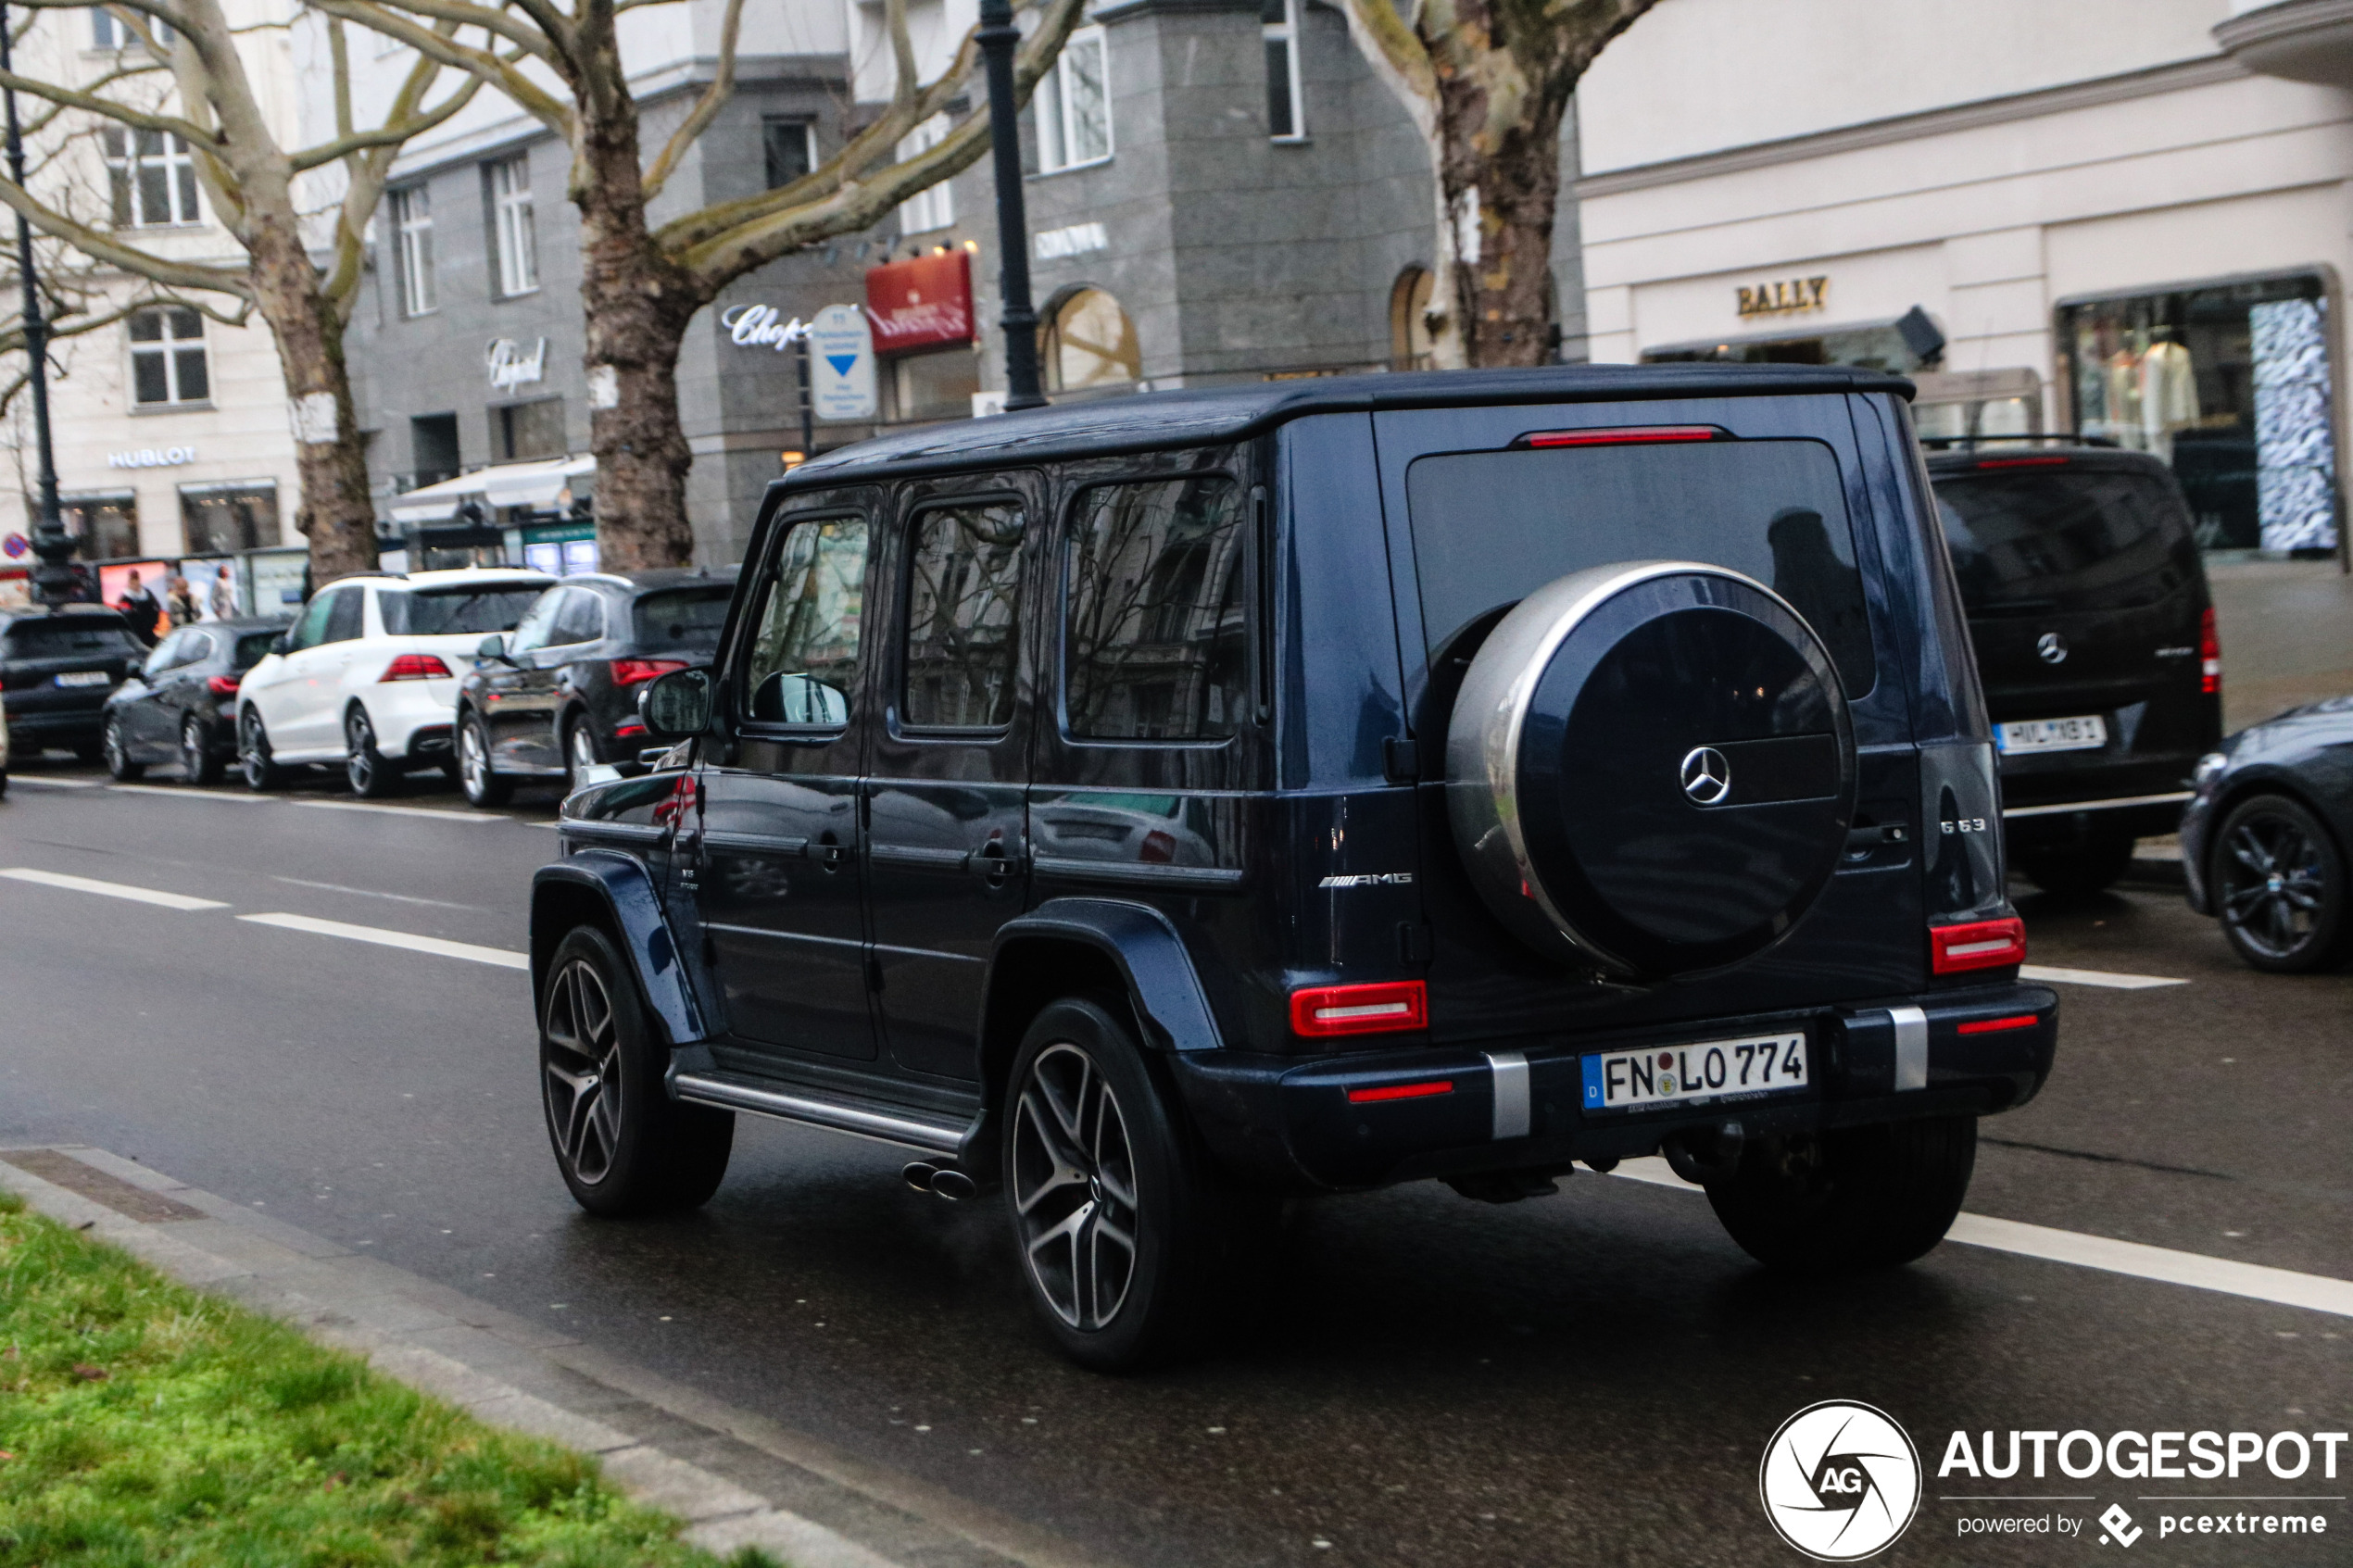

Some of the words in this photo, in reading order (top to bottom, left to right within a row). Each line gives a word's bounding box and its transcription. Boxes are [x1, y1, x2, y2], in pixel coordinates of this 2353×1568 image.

[1735, 275, 1830, 317] BALLY
[107, 445, 195, 469] HUBLOT
[1940, 821, 1955, 834] G
[1957, 818, 1986, 834] 63
[1352, 872, 1413, 886] AMG
[1604, 1054, 1655, 1100] FN
[1679, 1047, 1727, 1092] LO
[1734, 1039, 1803, 1085] 774
[1588, 1085, 1598, 1098] D
